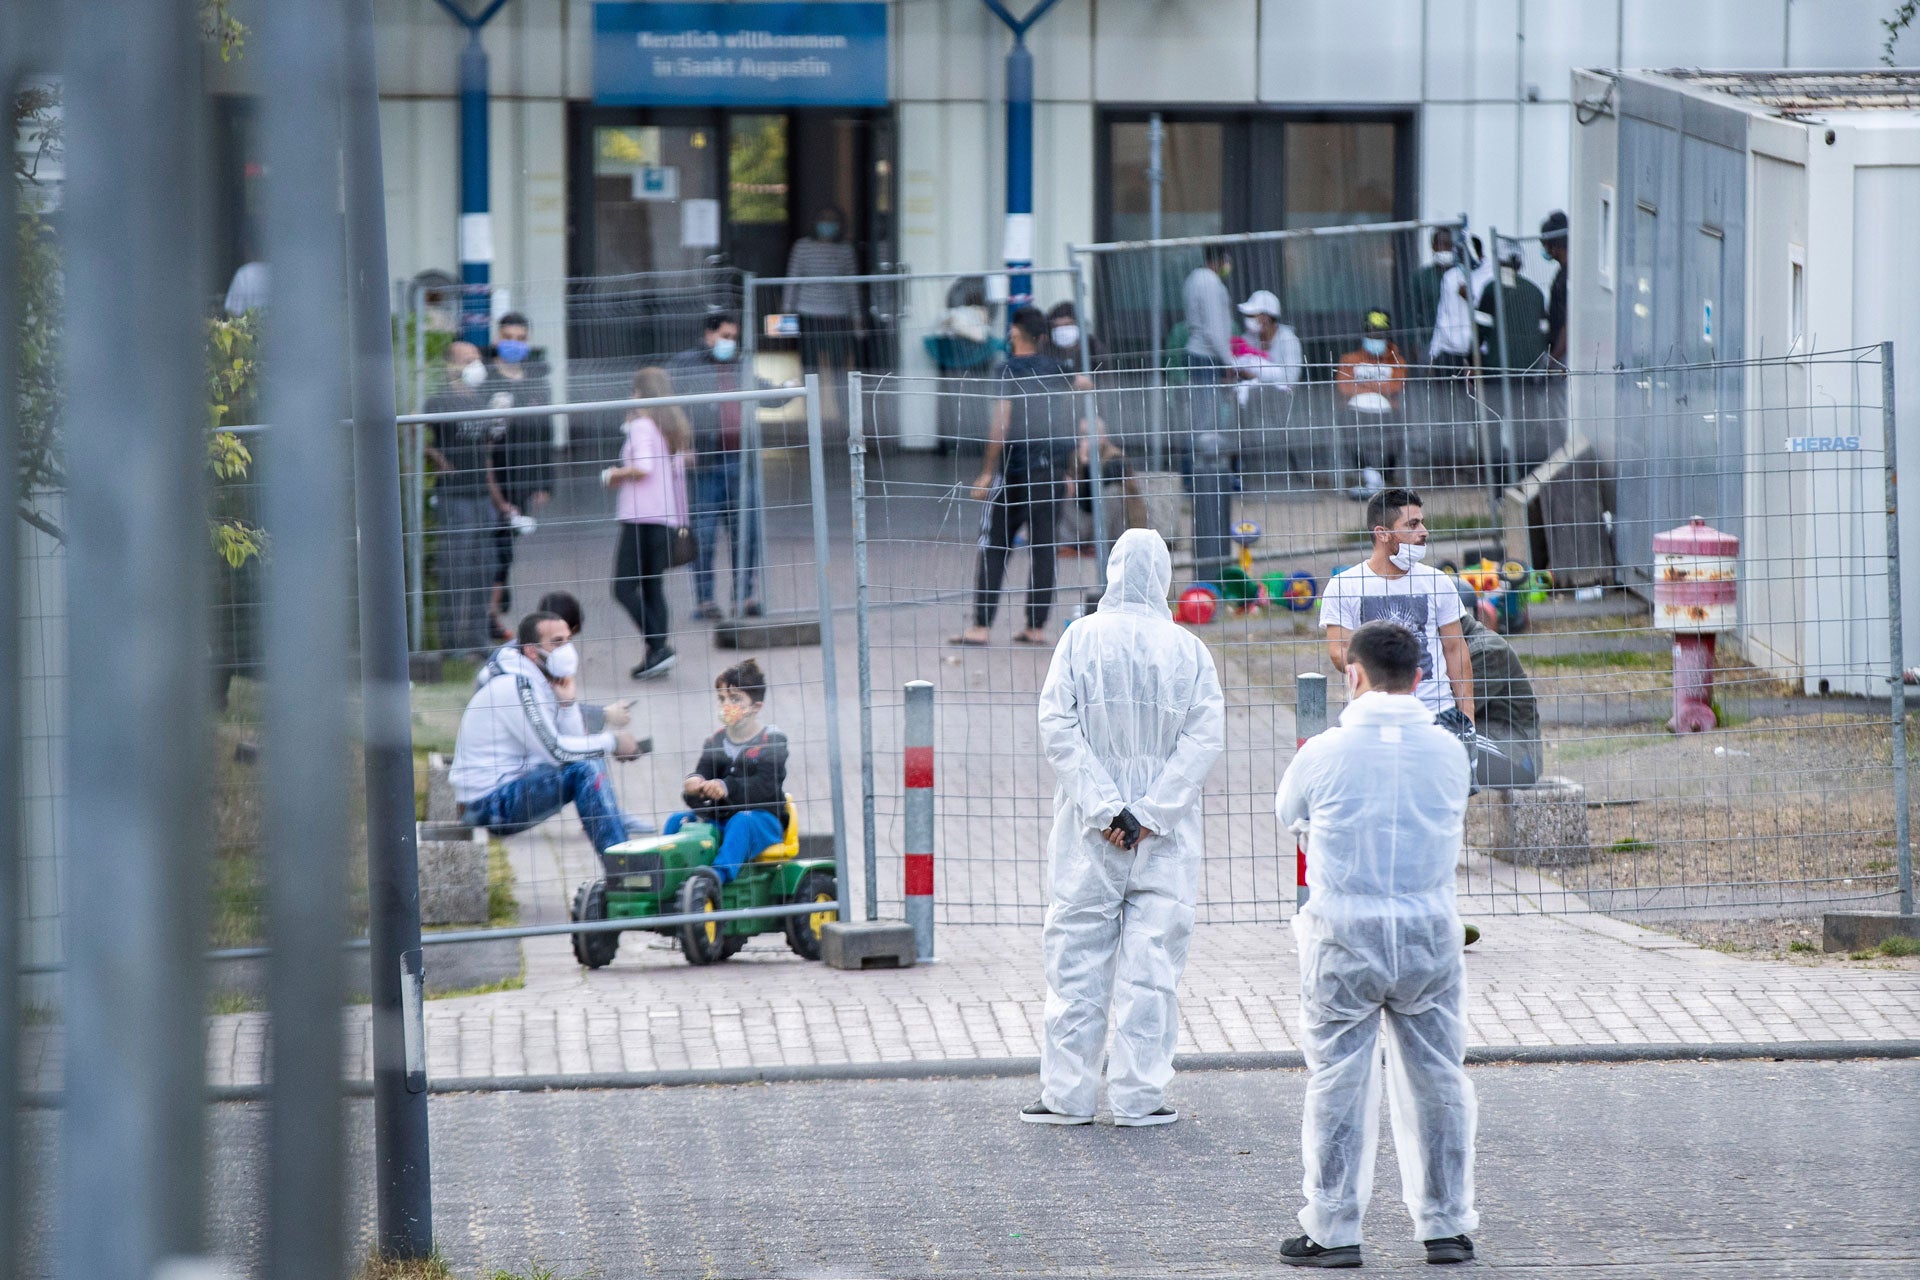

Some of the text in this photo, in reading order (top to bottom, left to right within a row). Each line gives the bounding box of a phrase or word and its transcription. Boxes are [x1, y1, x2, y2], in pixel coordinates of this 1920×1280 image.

[637, 30, 847, 48] Herzlich willkommen
[653, 56, 829, 80] in Sankt Augustin
[1792, 437, 1859, 451] HERAS
